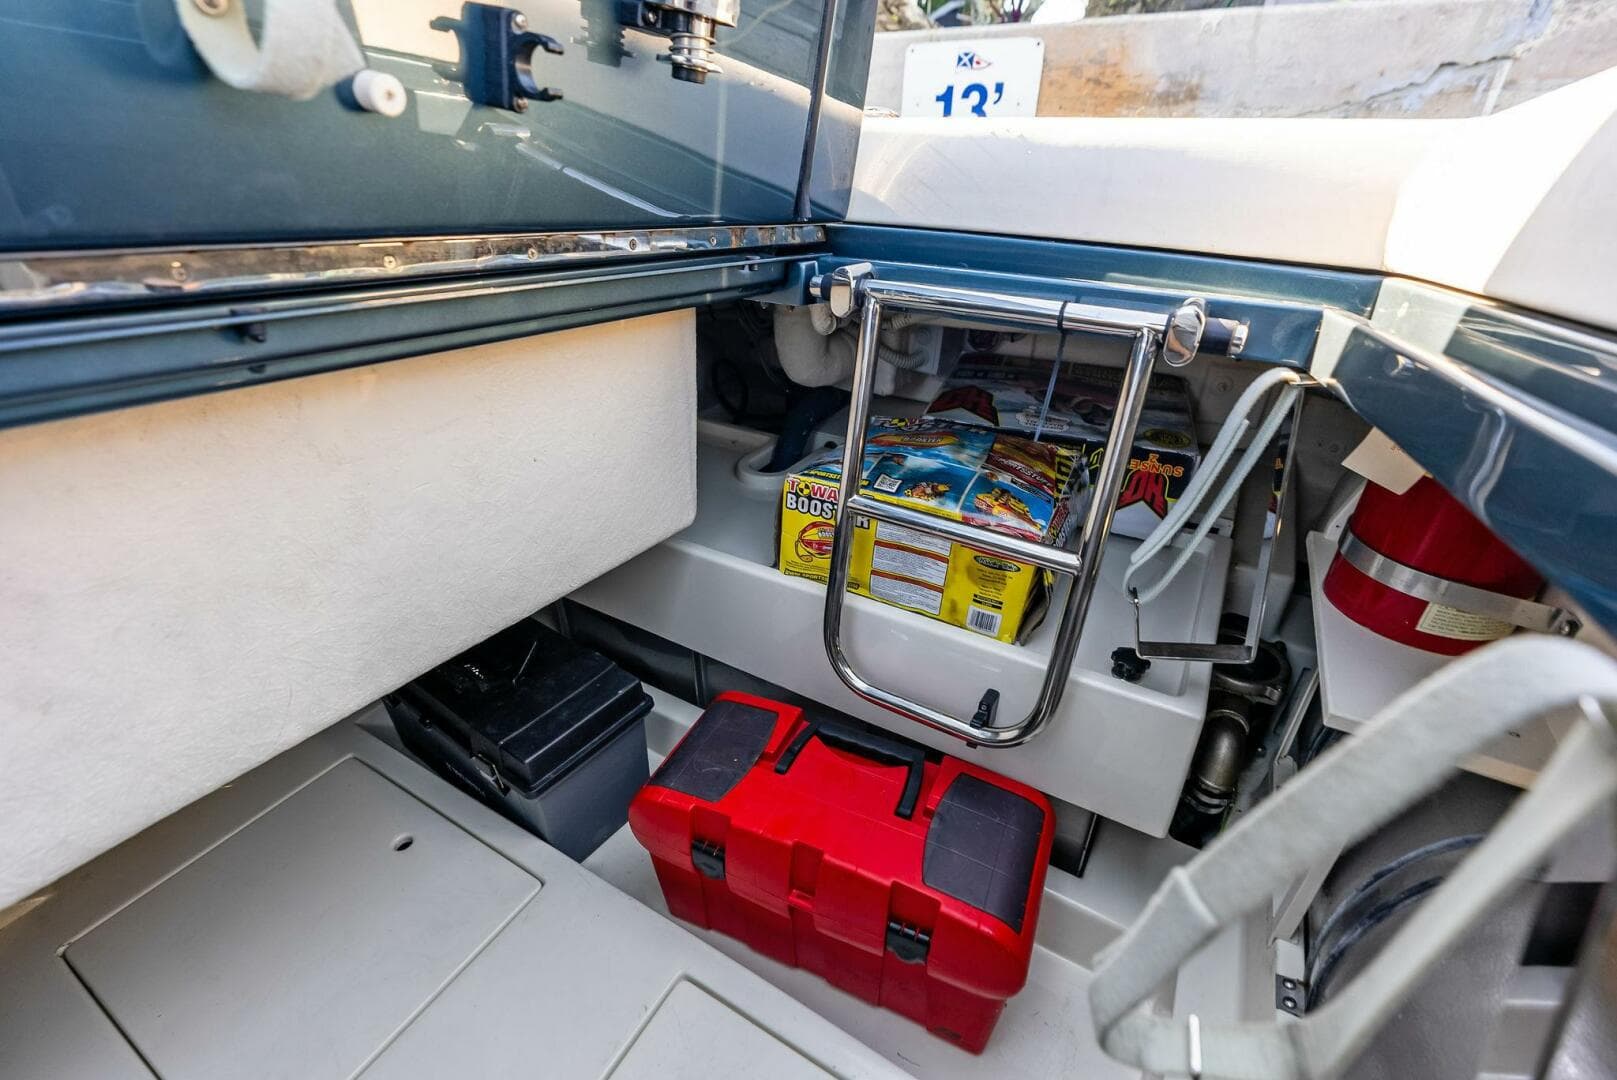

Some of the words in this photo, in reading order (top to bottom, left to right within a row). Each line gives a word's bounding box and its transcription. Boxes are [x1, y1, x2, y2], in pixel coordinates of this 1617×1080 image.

[935, 82, 1004, 118] 13'
[1129, 457, 1185, 478] SUNSE
[788, 480, 839, 504] TOWA
